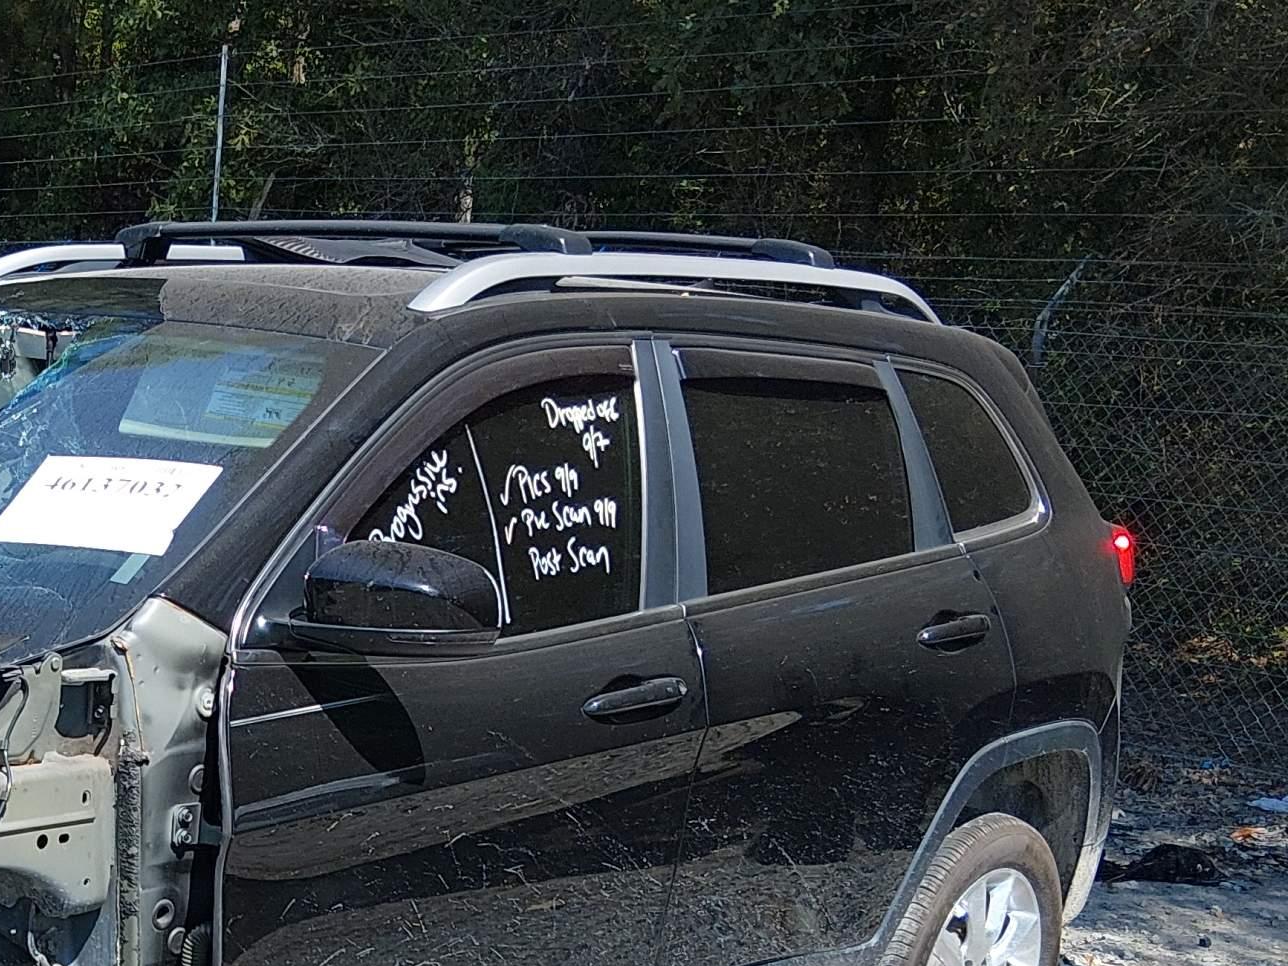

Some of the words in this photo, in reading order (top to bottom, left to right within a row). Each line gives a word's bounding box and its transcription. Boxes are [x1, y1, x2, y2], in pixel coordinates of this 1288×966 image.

[540, 397, 596, 434] Dropped
[581, 424, 611, 469] 9/7
[512, 465, 552, 505] Pics
[554, 462, 579, 498] 9/9
[520, 508, 550, 538] Pre
[551, 500, 593, 532] Scan
[593, 497, 617, 529] 9/9
[528, 546, 562, 581] Post
[566, 536, 610, 575] Scan
